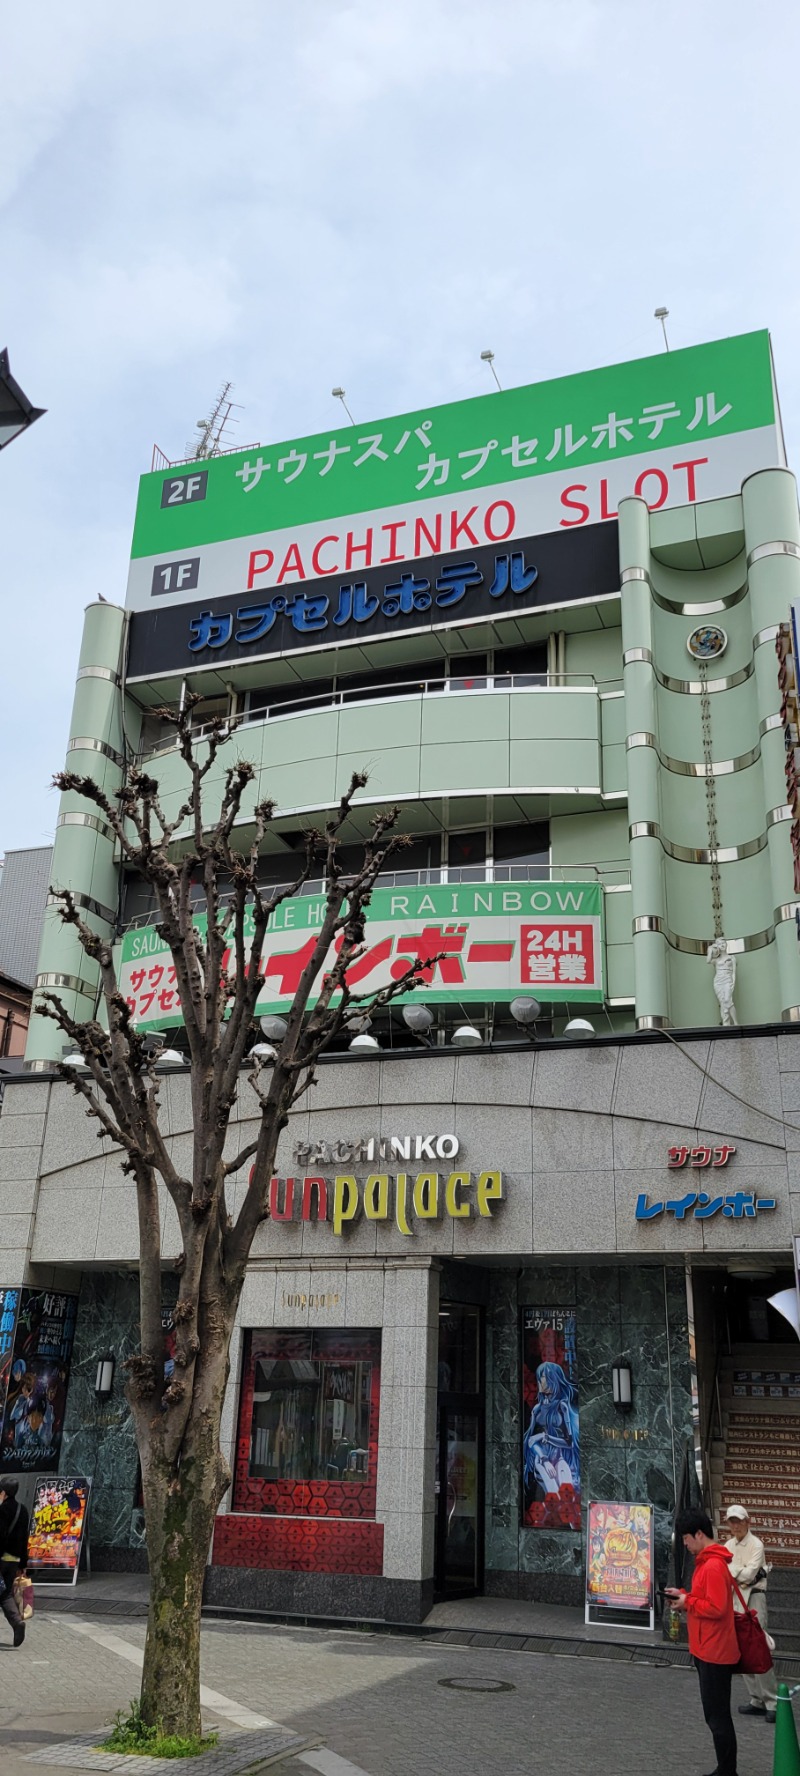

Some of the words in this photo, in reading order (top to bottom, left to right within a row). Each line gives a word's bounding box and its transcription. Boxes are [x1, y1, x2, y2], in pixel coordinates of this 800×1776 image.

[235, 419, 433, 493] サウナスパ
[415, 391, 733, 491] カプセルホテル
[168, 476, 202, 503] 2F
[247, 499, 517, 589] PACHINKO
[559, 457, 709, 527] SLOT
[159, 563, 193, 592] 1F
[187, 551, 538, 651] カプセルホテル
[131, 932, 169, 958] SAUN
[390, 891, 585, 916] RAINBOW
[527, 930, 583, 952] 24H
[527, 954, 587, 983] 営業
[293, 1134, 460, 1166] PACHINKO
[667, 1145, 736, 1168] サウナ
[249, 1164, 502, 1236] unpalace
